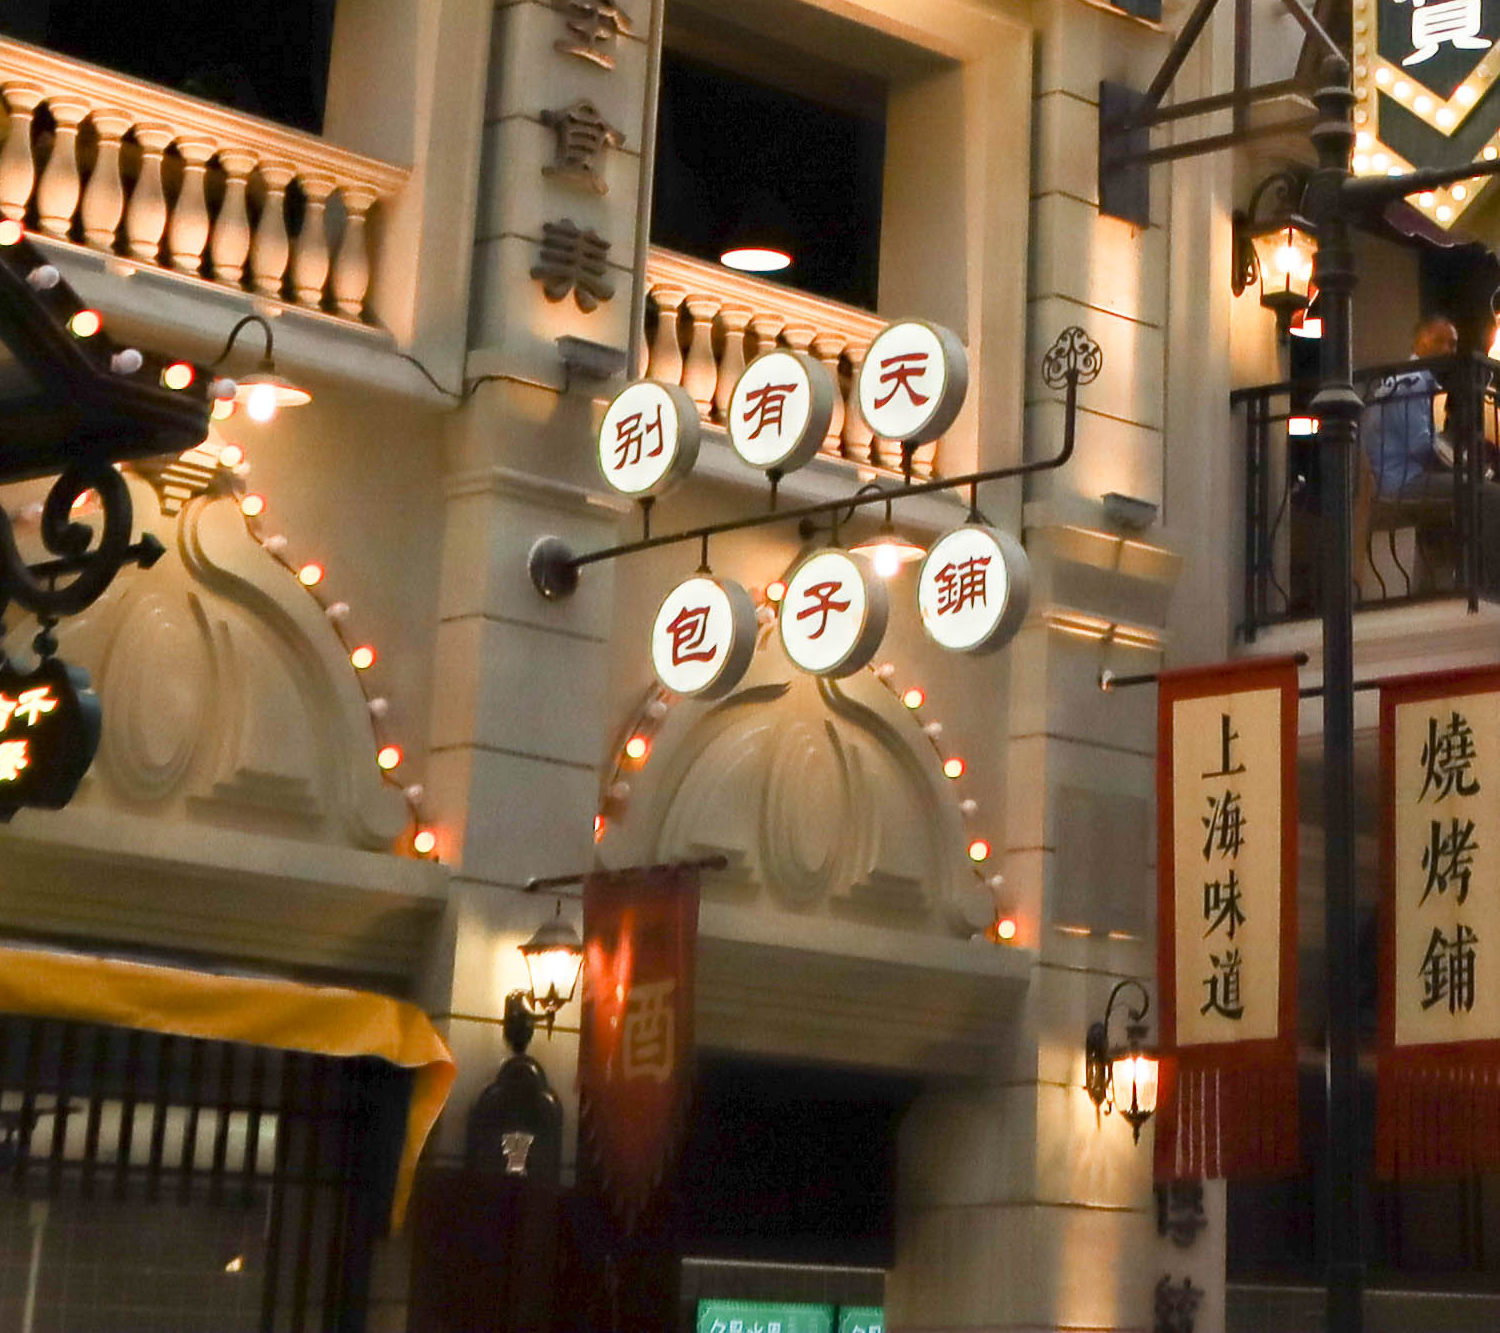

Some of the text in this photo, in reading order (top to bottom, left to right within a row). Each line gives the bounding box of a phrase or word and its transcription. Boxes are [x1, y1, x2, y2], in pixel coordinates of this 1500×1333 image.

[1199, 712, 1247, 1021] 上海味道
[1417, 712, 1481, 1019] 燒烤鋪
